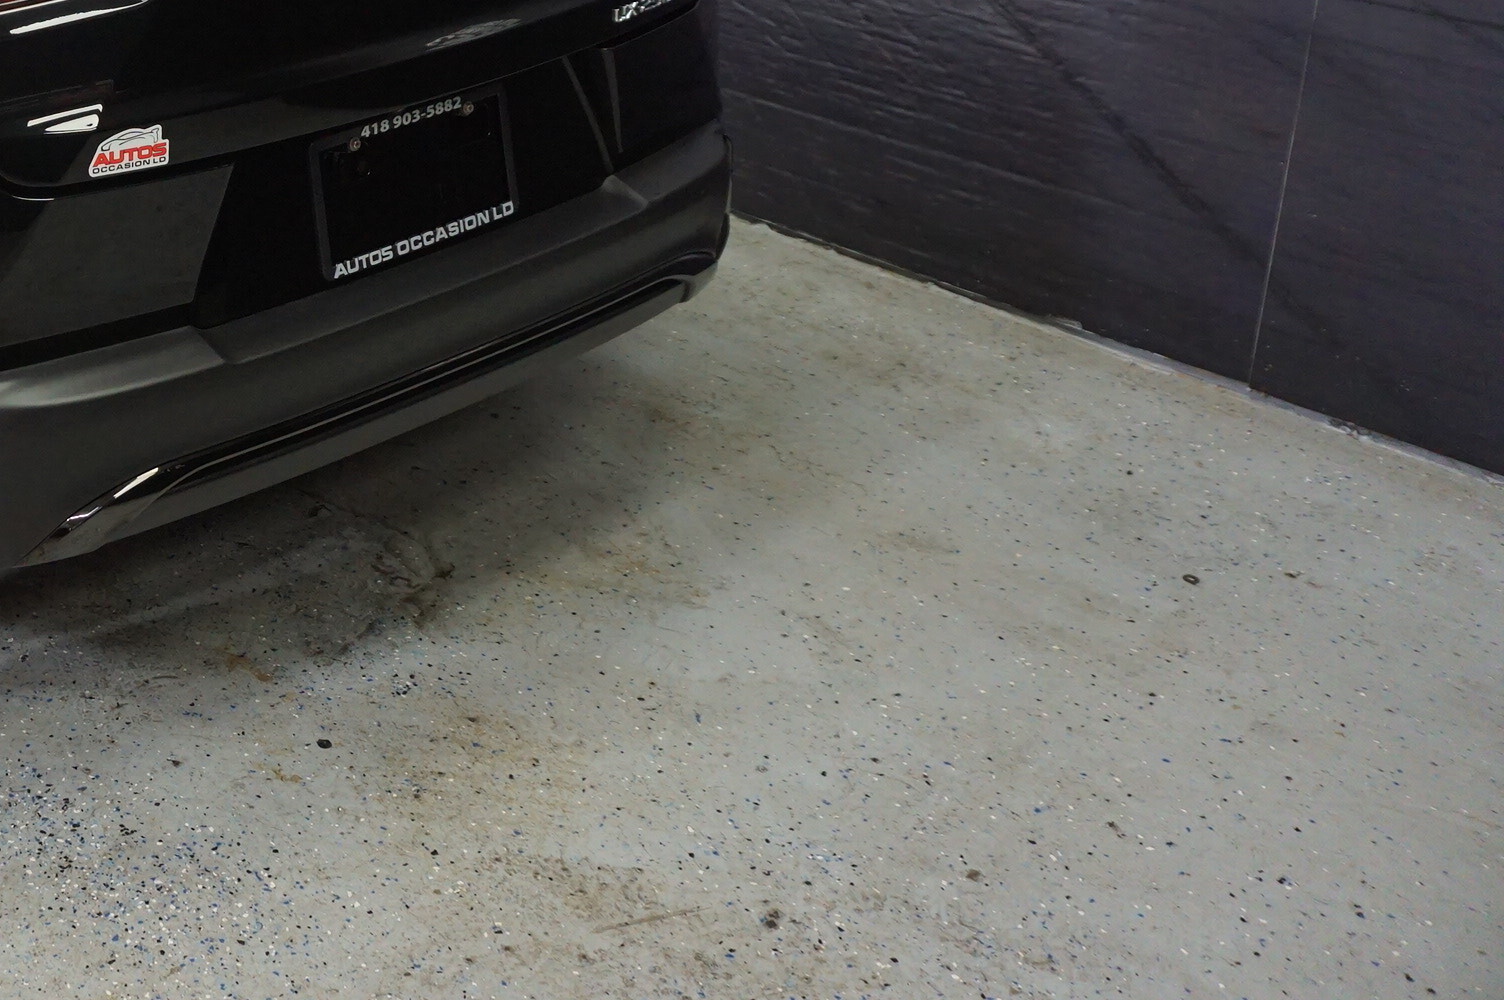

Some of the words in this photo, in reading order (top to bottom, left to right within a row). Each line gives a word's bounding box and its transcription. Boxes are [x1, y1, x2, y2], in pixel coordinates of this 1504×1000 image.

[360, 119, 391, 139] 418
[392, 96, 463, 130] 903-5882
[92, 142, 167, 168] AUTOS
[92, 159, 151, 175] OCCASION
[153, 156, 167, 164] LD
[333, 245, 394, 280] AUTOS
[395, 209, 490, 257] OCCASION
[492, 200, 515, 221] LD
